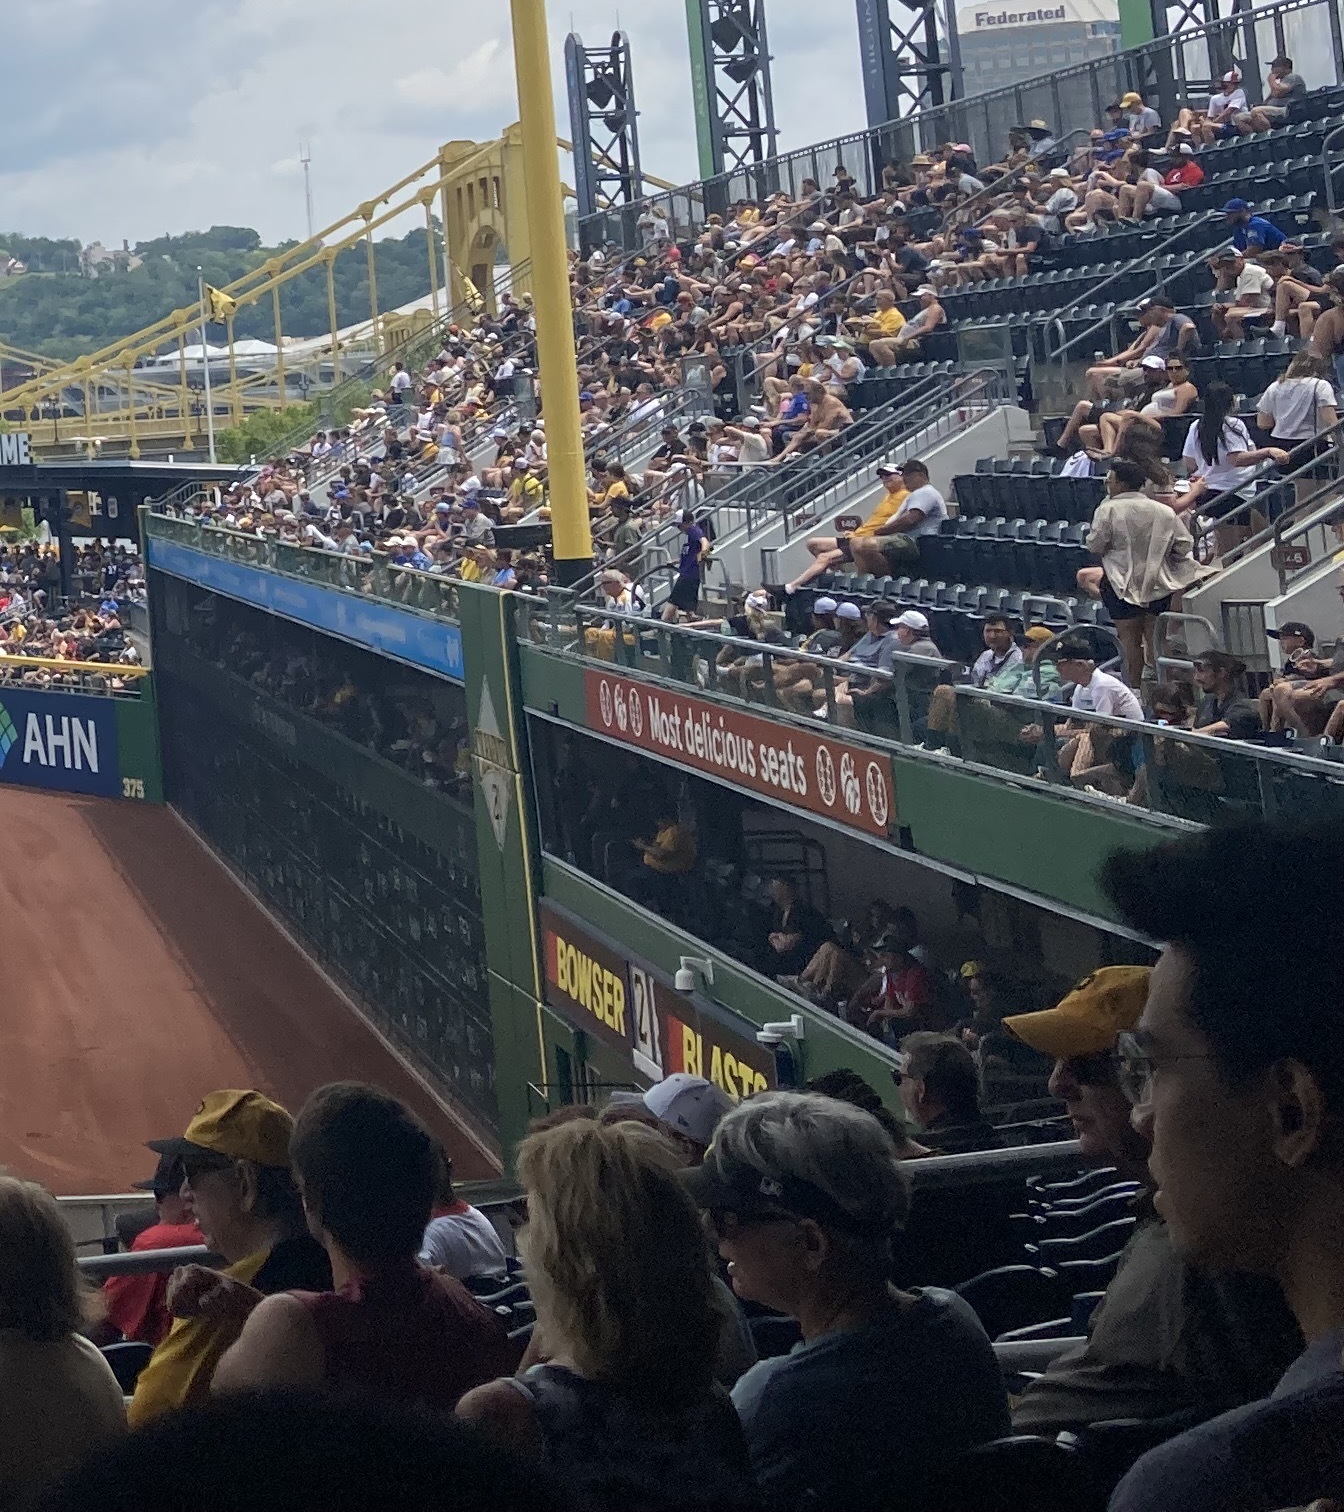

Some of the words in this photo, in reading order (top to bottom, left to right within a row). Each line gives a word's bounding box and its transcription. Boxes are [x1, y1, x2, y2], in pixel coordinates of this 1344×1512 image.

[975, 5, 1066, 27] Federated
[23, 712, 99, 774] AHN
[648, 695, 683, 751] Most
[684, 707, 757, 778] delicious
[759, 740, 808, 796] seats
[122, 776, 145, 800] 375
[556, 936, 626, 1038] BOWSER
